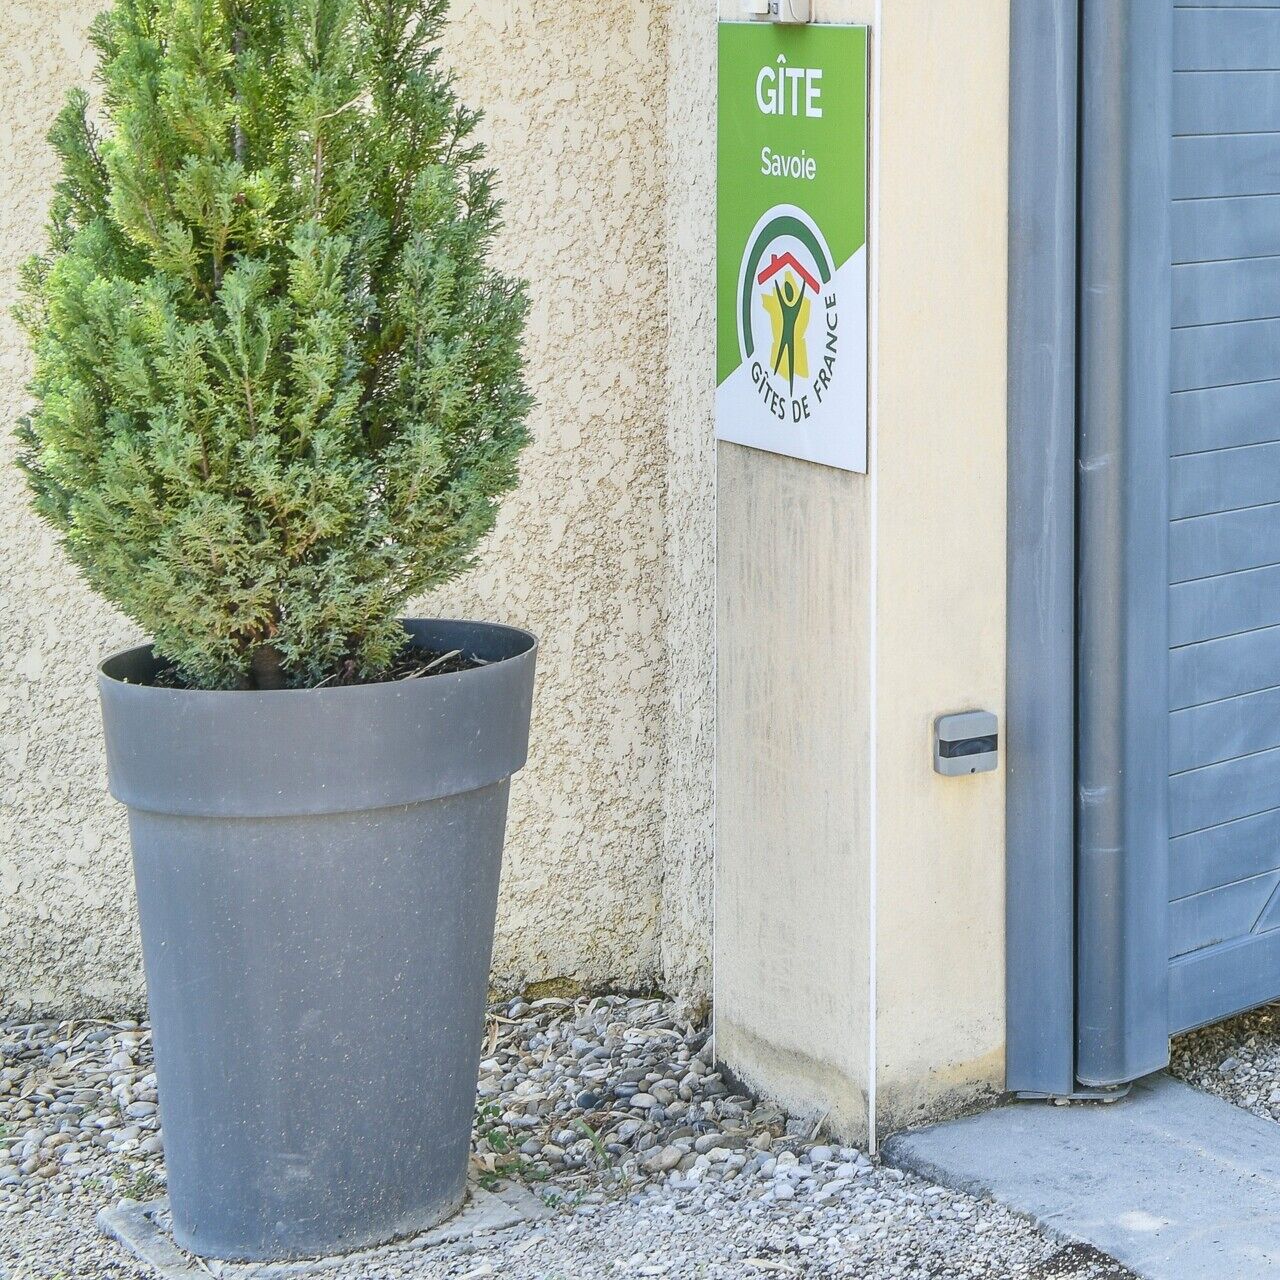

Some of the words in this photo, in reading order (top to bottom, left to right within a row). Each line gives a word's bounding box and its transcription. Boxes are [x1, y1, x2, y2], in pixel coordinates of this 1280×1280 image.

[756, 54, 822, 118] GÎTE
[761, 146, 817, 181] Savoie
[751, 361, 786, 420] GÎTES
[792, 394, 811, 423] DE
[813, 292, 838, 403] FRANCE
